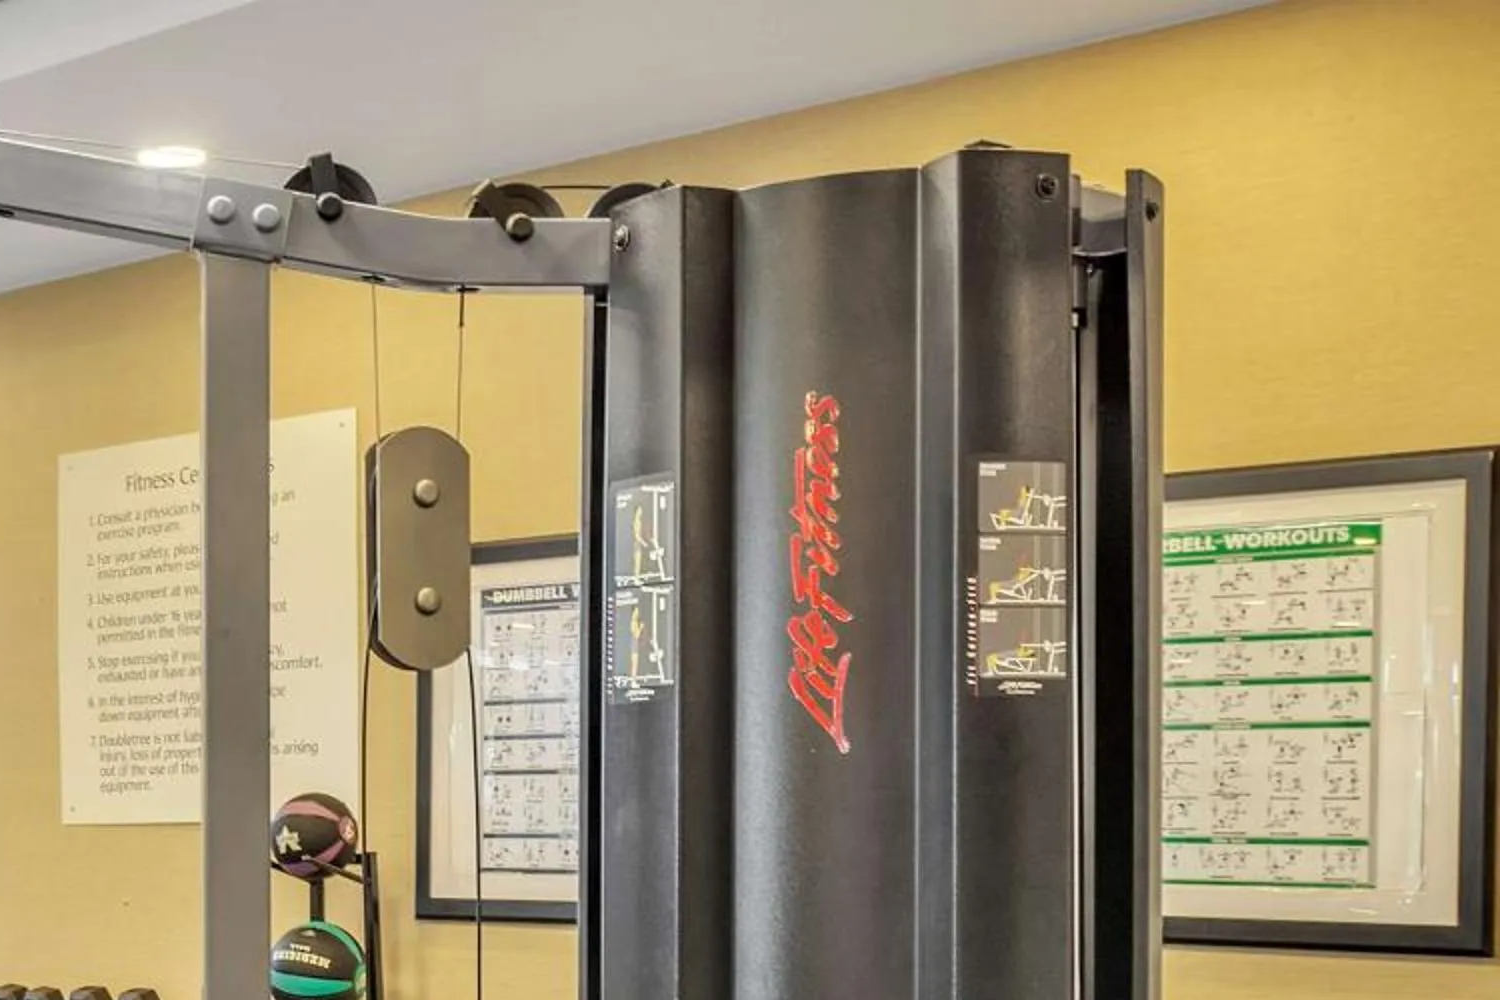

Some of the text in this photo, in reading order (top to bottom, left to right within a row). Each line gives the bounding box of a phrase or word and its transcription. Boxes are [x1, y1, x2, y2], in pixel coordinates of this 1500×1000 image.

[125, 466, 199, 492] Fitness Ce
[143, 504, 188, 523] physician
[1164, 525, 1350, 553] BELL WORKOUTS
[787, 390, 853, 754] Life Fitness
[116, 586, 167, 605] equipment
[98, 612, 138, 628] Children
